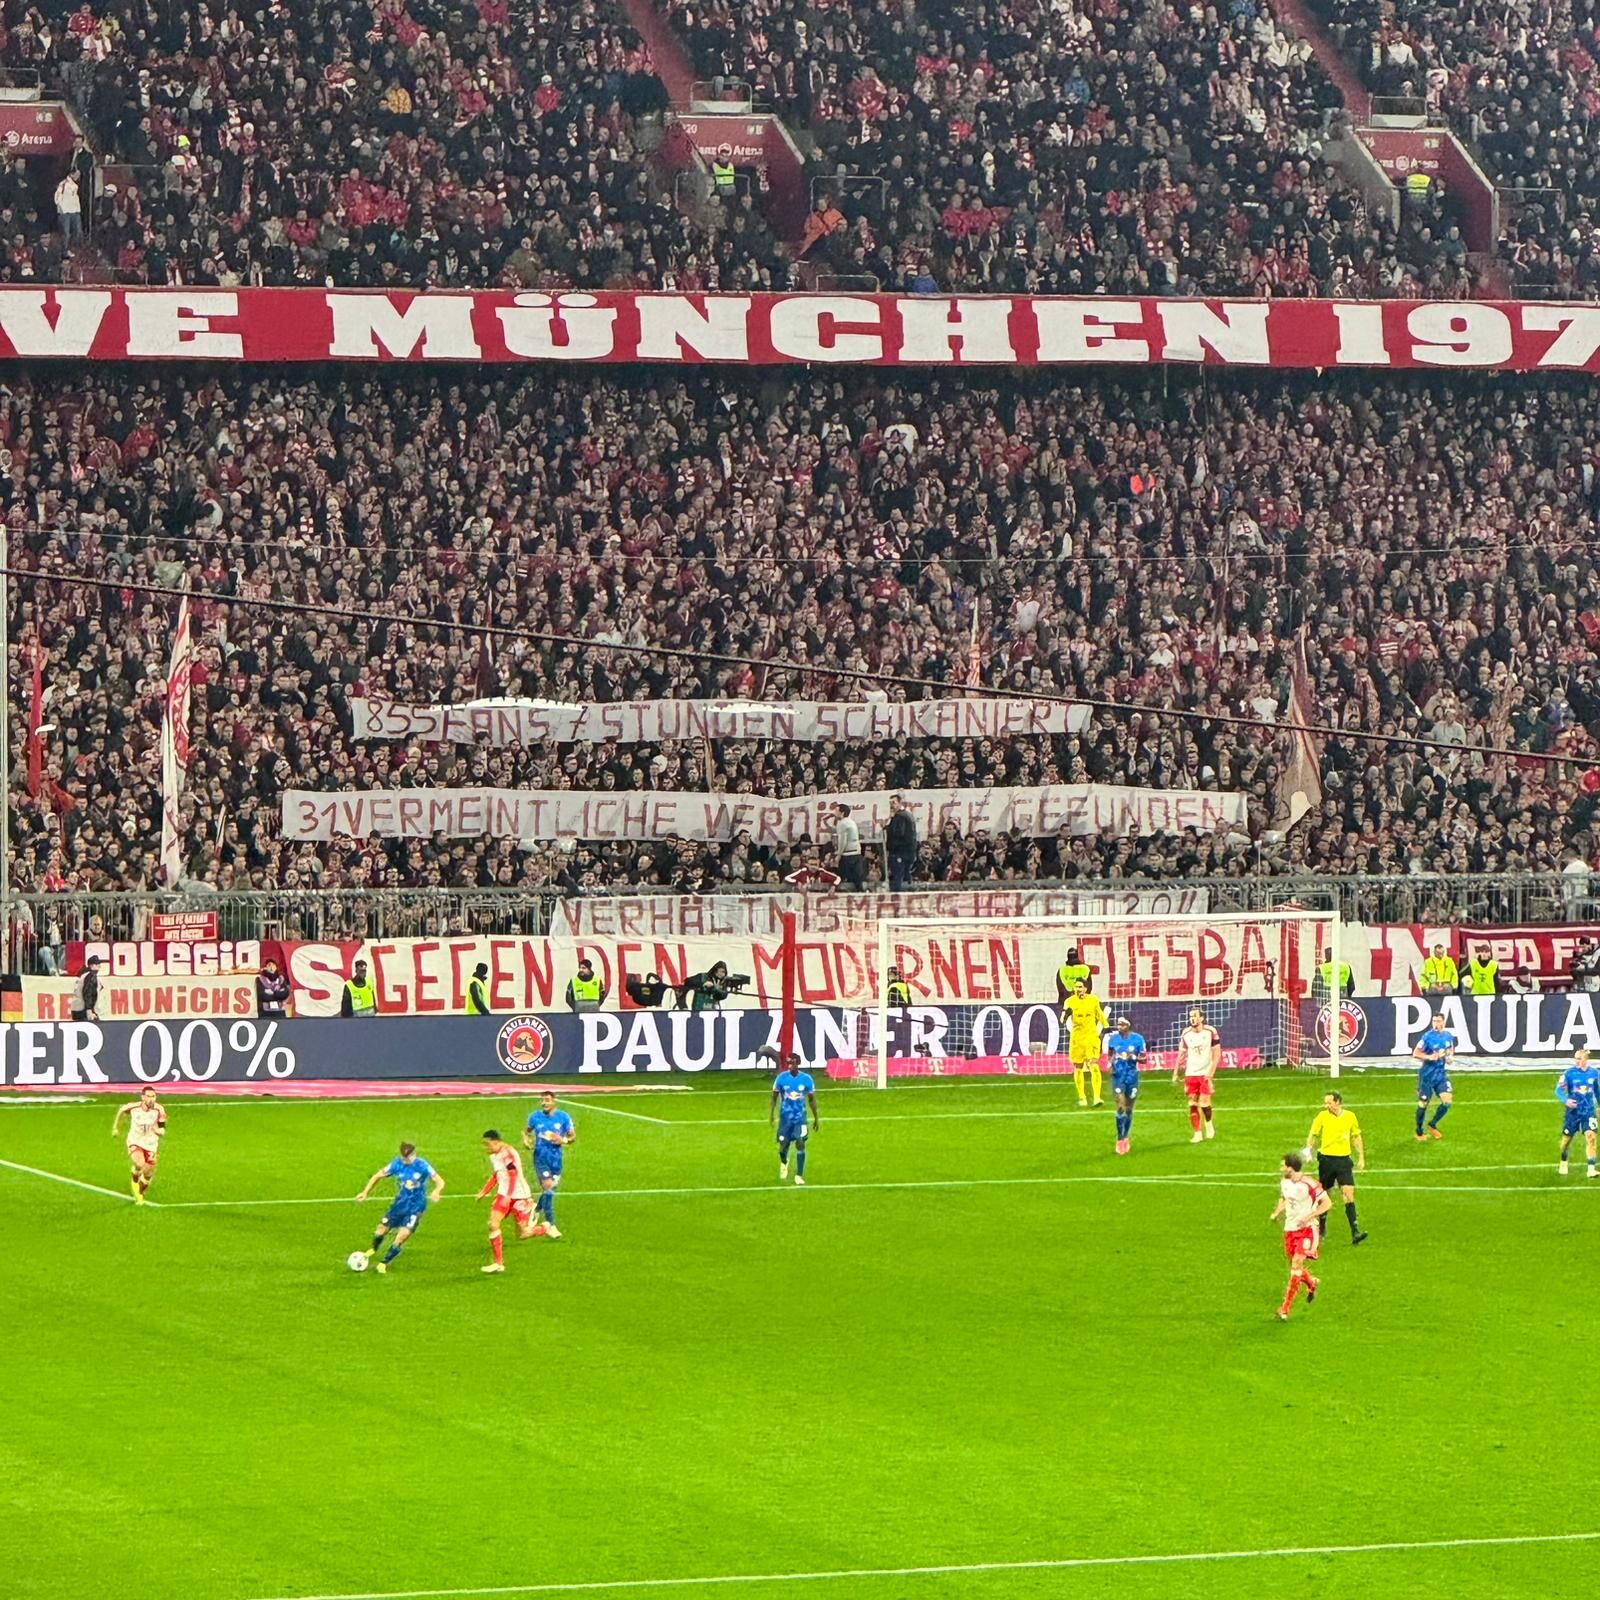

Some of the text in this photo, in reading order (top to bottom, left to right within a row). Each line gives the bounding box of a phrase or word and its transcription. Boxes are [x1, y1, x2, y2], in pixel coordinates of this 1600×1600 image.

[21, 133, 53, 145] Arena
[0, 291, 244, 359] VE
[1333, 302, 1600, 370] 197
[366, 699, 437, 735] 855
[602, 701, 796, 743] STUNDEN
[817, 701, 1074, 742] SCHIKANIERT
[298, 795, 1224, 845] 31 VERMEINTLICHE VERDÄHIGE GEFUNDEN
[576, 943, 689, 1010] DEN
[752, 936, 1023, 1008] MODERNEN
[37, 993, 77, 1020] RE
[501, 1018, 548, 1039] PAULANER
[1319, 1002, 1363, 1023] PAANER
[1390, 993, 1600, 1056] PAULA
[129, 1020, 296, 1083] 0,0%
[578, 1006, 949, 1073] PAULANER
